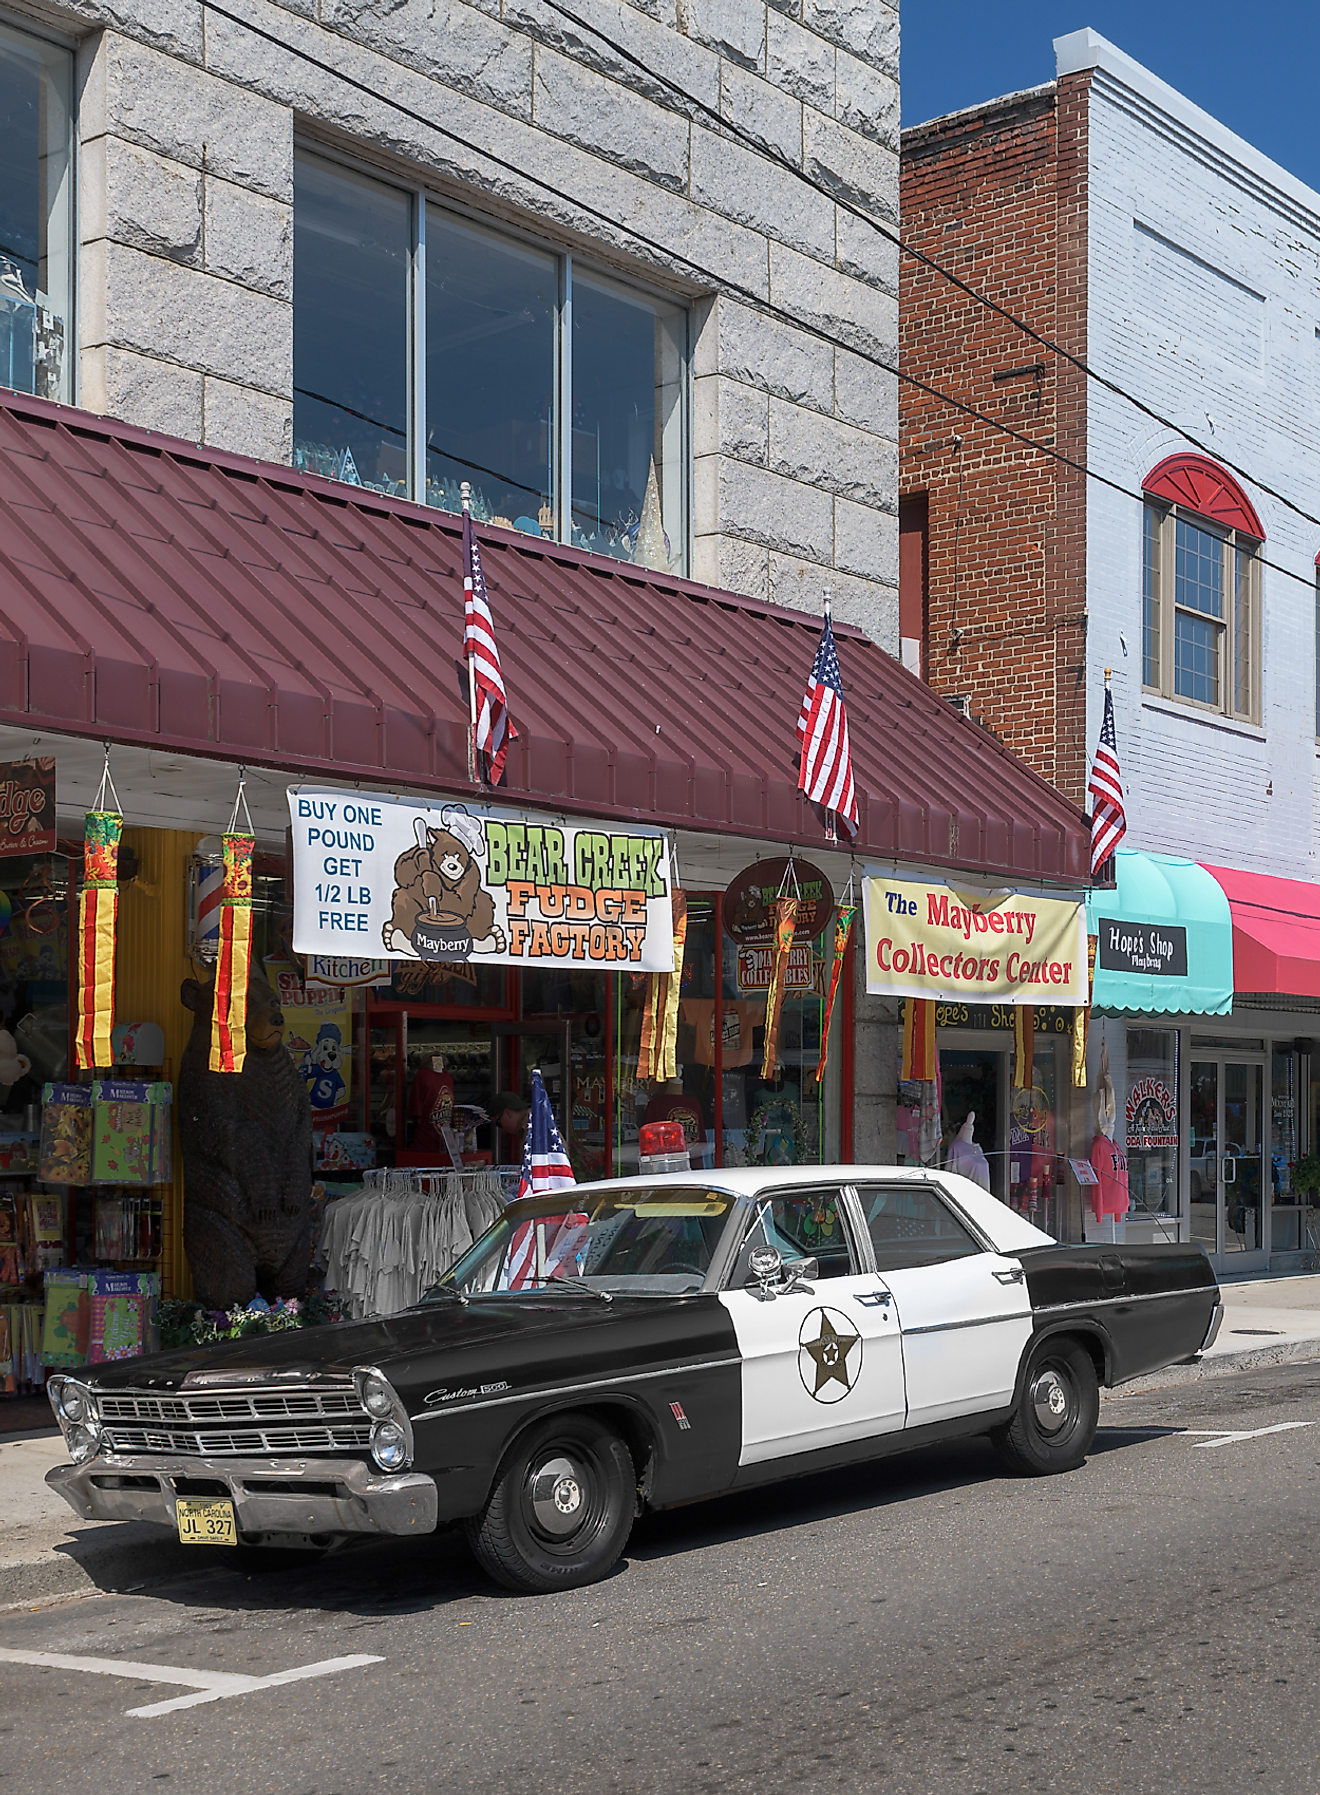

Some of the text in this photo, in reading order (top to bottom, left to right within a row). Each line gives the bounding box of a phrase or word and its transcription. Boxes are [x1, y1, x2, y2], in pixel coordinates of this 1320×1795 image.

[298, 799, 383, 826] BUY ONE
[308, 827, 375, 852] POUND
[323, 857, 362, 877] GET
[484, 820, 667, 899] BEAR CREEK
[314, 883, 371, 905] 1/2 LB
[506, 879, 647, 925] FUDGE
[319, 911, 369, 932] FREE
[885, 892, 1036, 944] The Mayberry
[416, 933, 469, 953] Mayberry
[507, 917, 646, 962] FACTORY
[1109, 927, 1174, 961] Hope's Shop
[313, 956, 383, 979] Kitchen
[877, 937, 1073, 985] Collectors Center
[396, 966, 445, 995] gifts
[936, 1005, 969, 1027] ope's
[317, 1080, 333, 1099] S
[1126, 1077, 1177, 1122] WALKER'S
[1126, 1135, 1178, 1147] ODA FOUNTAIN
[423, 1382, 507, 1404] Custom 500
[179, 1509, 232, 1518] NORTH CAROLINA
[183, 1519, 231, 1535] JL 327
